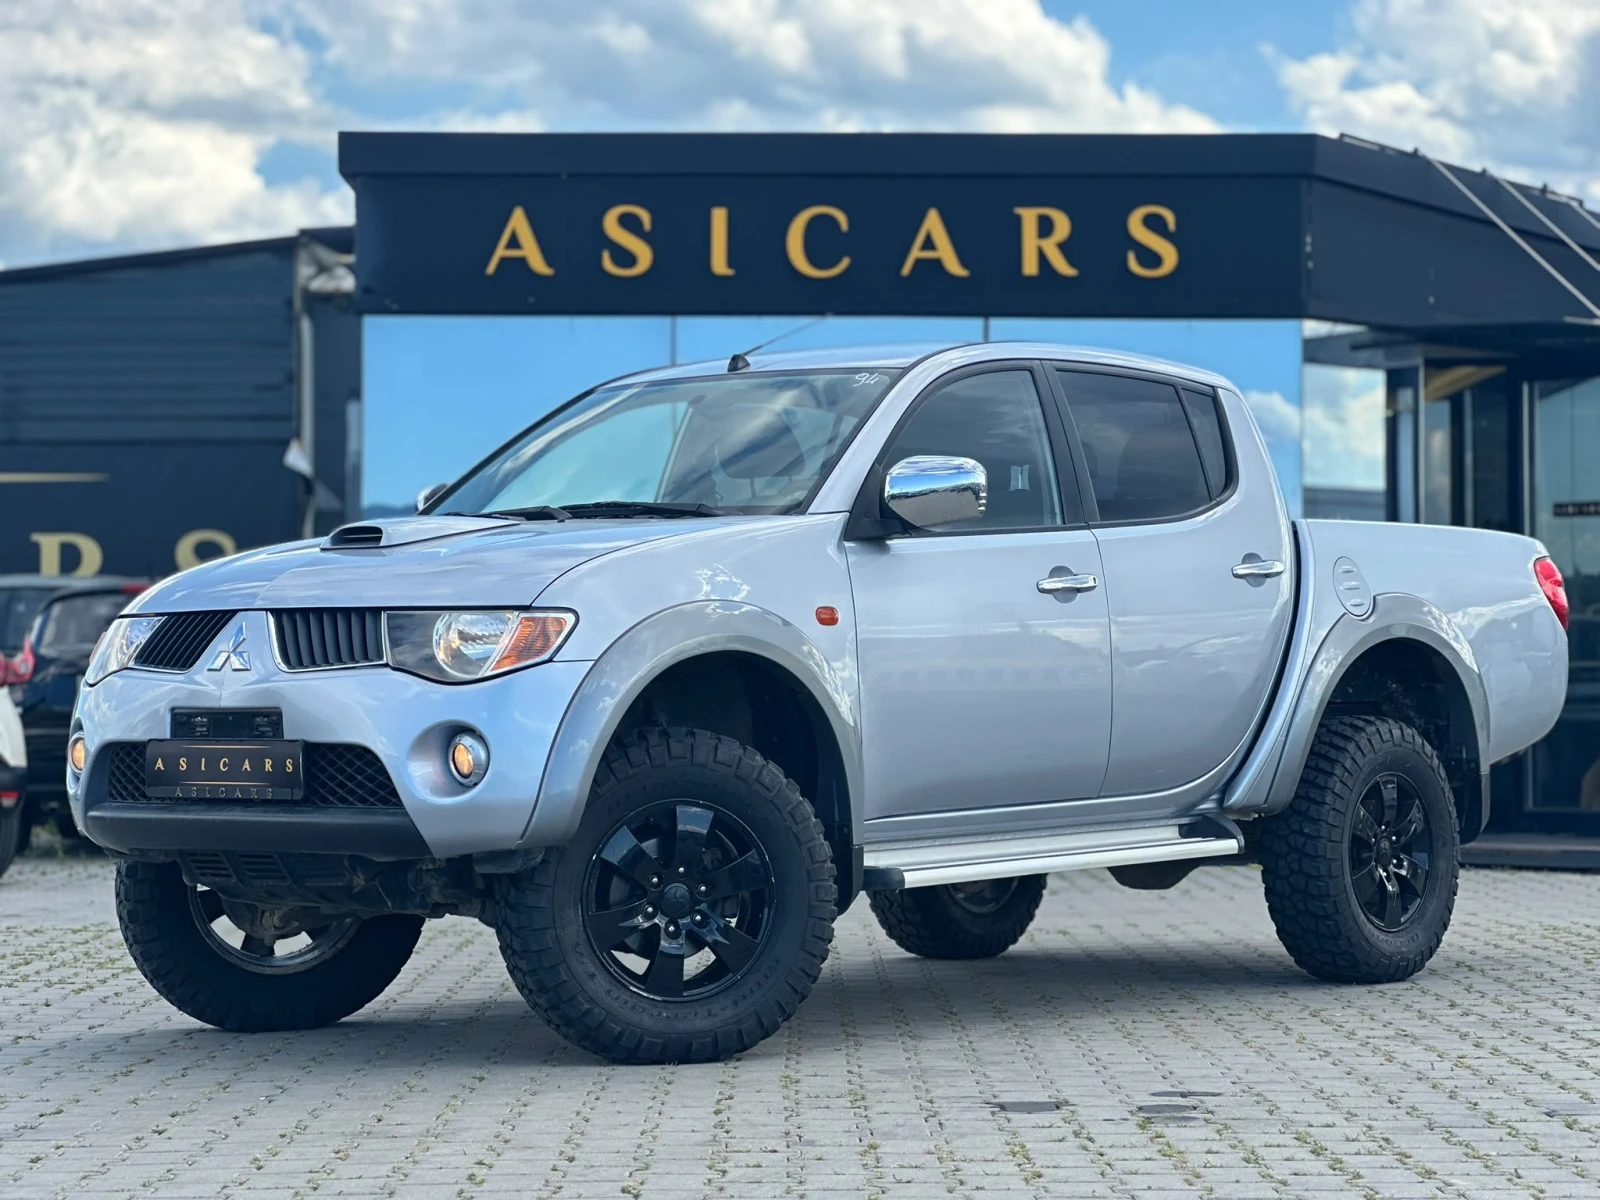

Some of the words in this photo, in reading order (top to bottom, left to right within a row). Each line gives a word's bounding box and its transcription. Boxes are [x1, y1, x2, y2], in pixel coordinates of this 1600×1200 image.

[484, 203, 1180, 279] ASICARS
[154, 757, 293, 773] ASICARS
[174, 786, 272, 799] ASICARS
